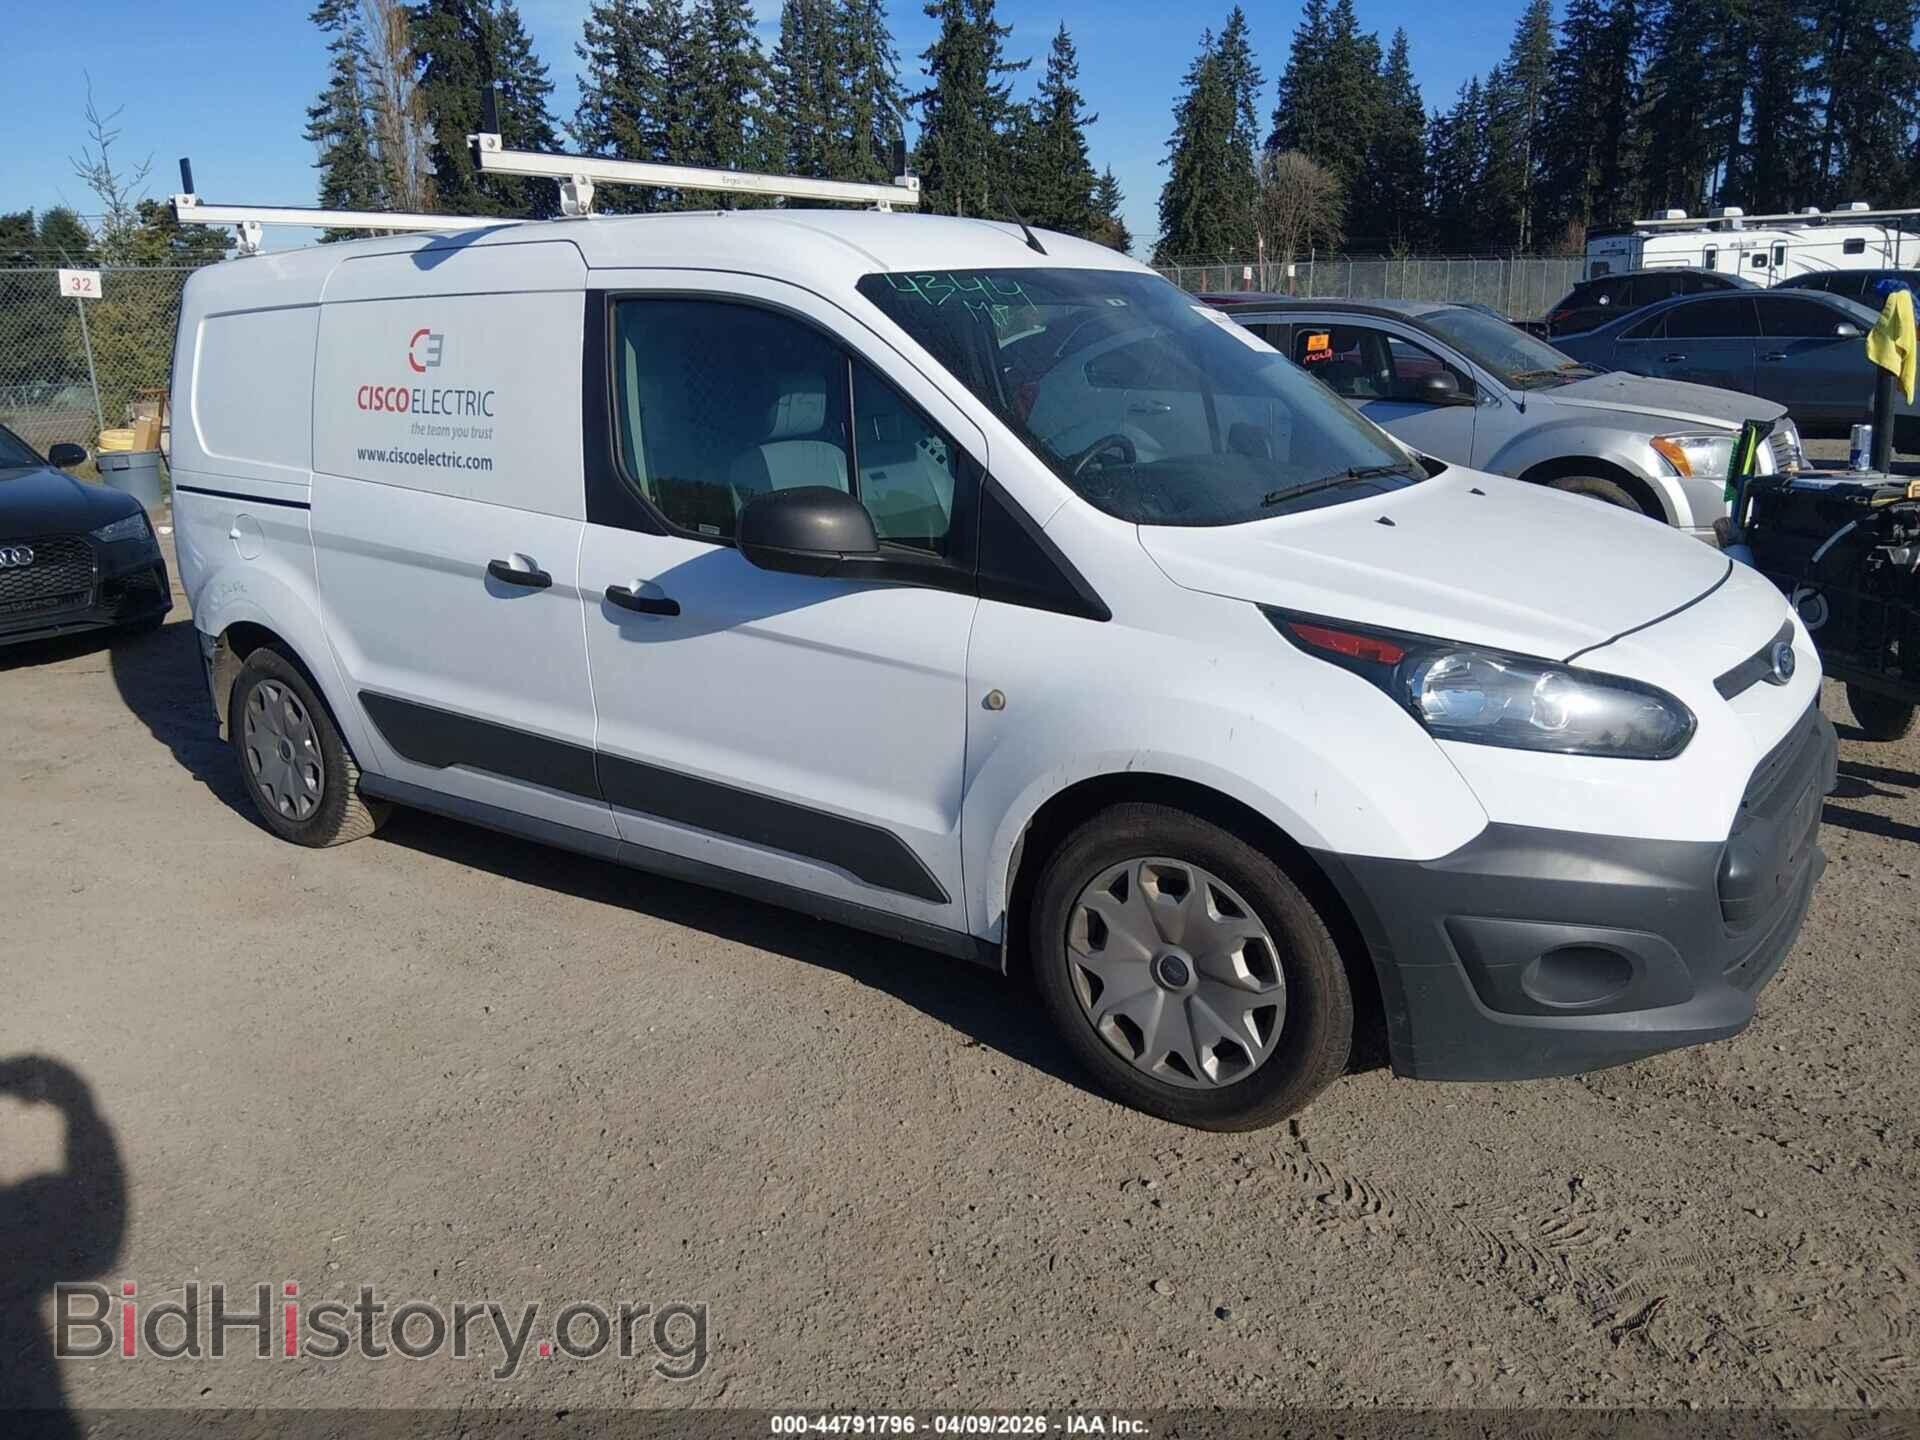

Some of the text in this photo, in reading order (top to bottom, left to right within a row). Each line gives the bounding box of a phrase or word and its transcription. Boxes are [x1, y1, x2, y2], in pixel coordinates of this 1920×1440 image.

[71, 276, 92, 292] 32
[884, 273, 1039, 312] 4344
[411, 422, 493, 440] the team you trust
[357, 447, 493, 471] www.ciscoelectric.com
